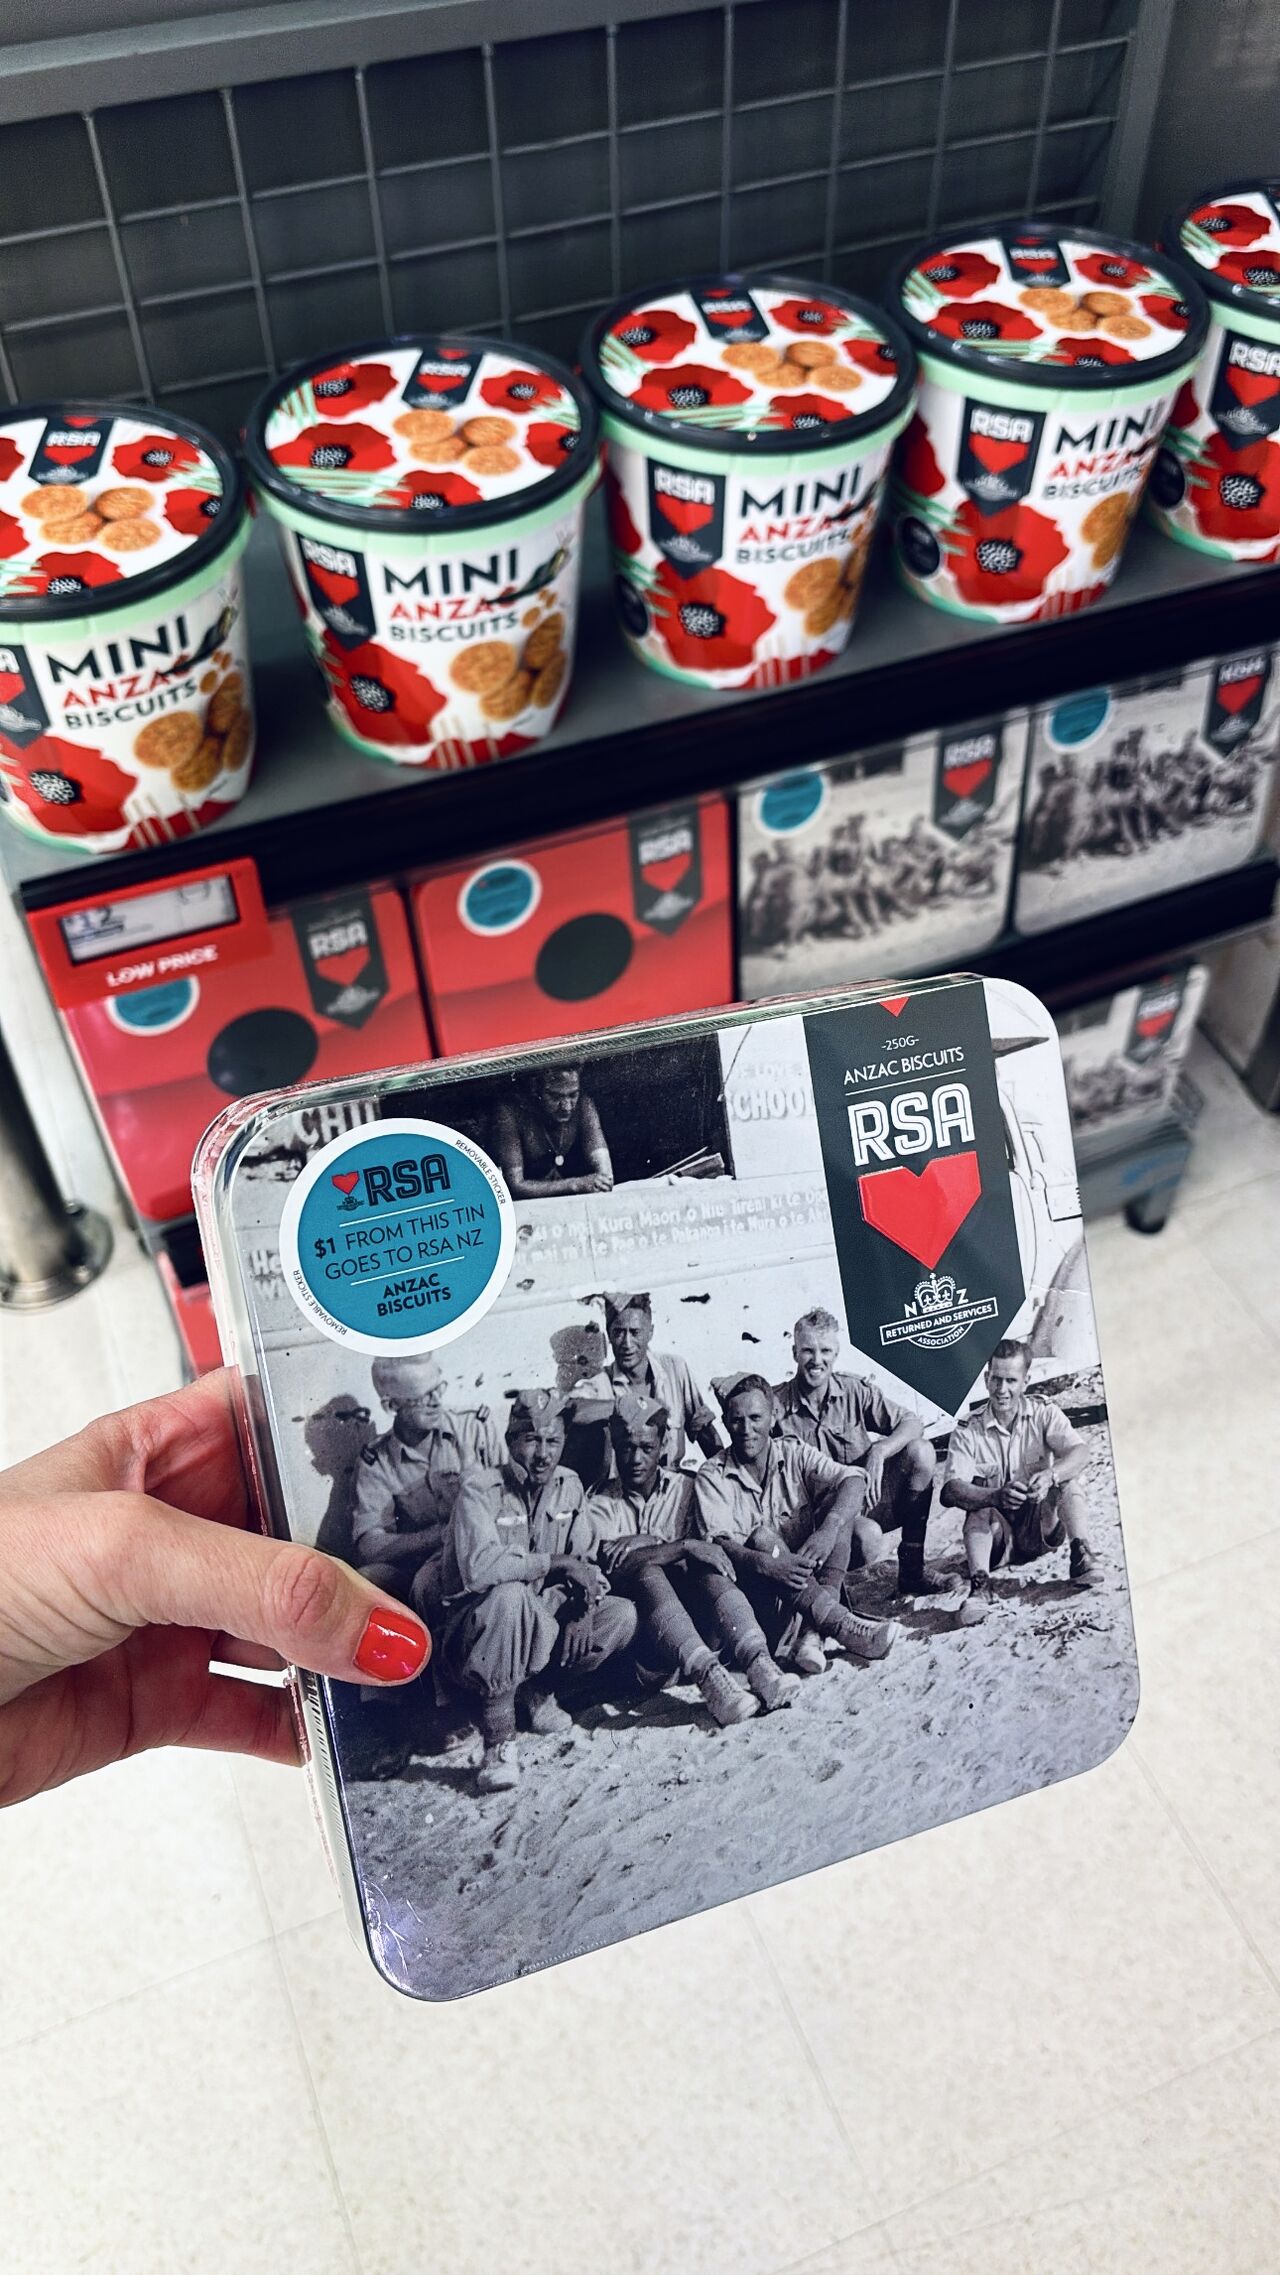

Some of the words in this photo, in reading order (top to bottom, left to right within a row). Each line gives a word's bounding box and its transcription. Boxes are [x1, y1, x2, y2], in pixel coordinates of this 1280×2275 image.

[970, 408, 1035, 444] RSA
[653, 467, 716, 504] RSA
[741, 464, 861, 518] MINI
[383, 548, 519, 596] MINI
[390, 610, 520, 643] BISCUITS
[46, 614, 190, 684] MINI
[64, 676, 200, 730] BISCUITS
[308, 919, 369, 961] RSA
[105, 961, 155, 988] LOW
[156, 944, 219, 975] PRICE
[843, 1059, 900, 1086] ANZAC
[901, 1046, 965, 1074] BISCUITS
[847, 1082, 976, 1168] RSA
[362, 1153, 451, 1207] RSA
[455, 1139, 491, 1180] REMOVABLE
[488, 1174, 507, 1205] STICKER
[313, 1237, 337, 1259] $1
[344, 1222, 404, 1251] FROM
[406, 1211, 450, 1236] THIS
[452, 1203, 486, 1226] TIN
[598, 1214, 634, 1234] Kura
[638, 1208, 681, 1228] Maori
[324, 1253, 382, 1281] GOES
[383, 1246, 413, 1268] TO
[418, 1238, 455, 1260] RSA
[456, 1228, 485, 1249] NZ
[293, 1269, 312, 1302] STICKER
[376, 1286, 452, 1317] BISCUITS
[382, 1273, 441, 1299] ANZAC
[903, 1301, 918, 1318] N
[955, 1288, 969, 1305] Z
[308, 1301, 348, 1337] REMOVABLE
[885, 1319, 933, 1339] RETURNED
[933, 1314, 952, 1327] AND
[953, 1303, 993, 1321] SERVICES
[917, 1326, 965, 1346] ASSOCIATION
